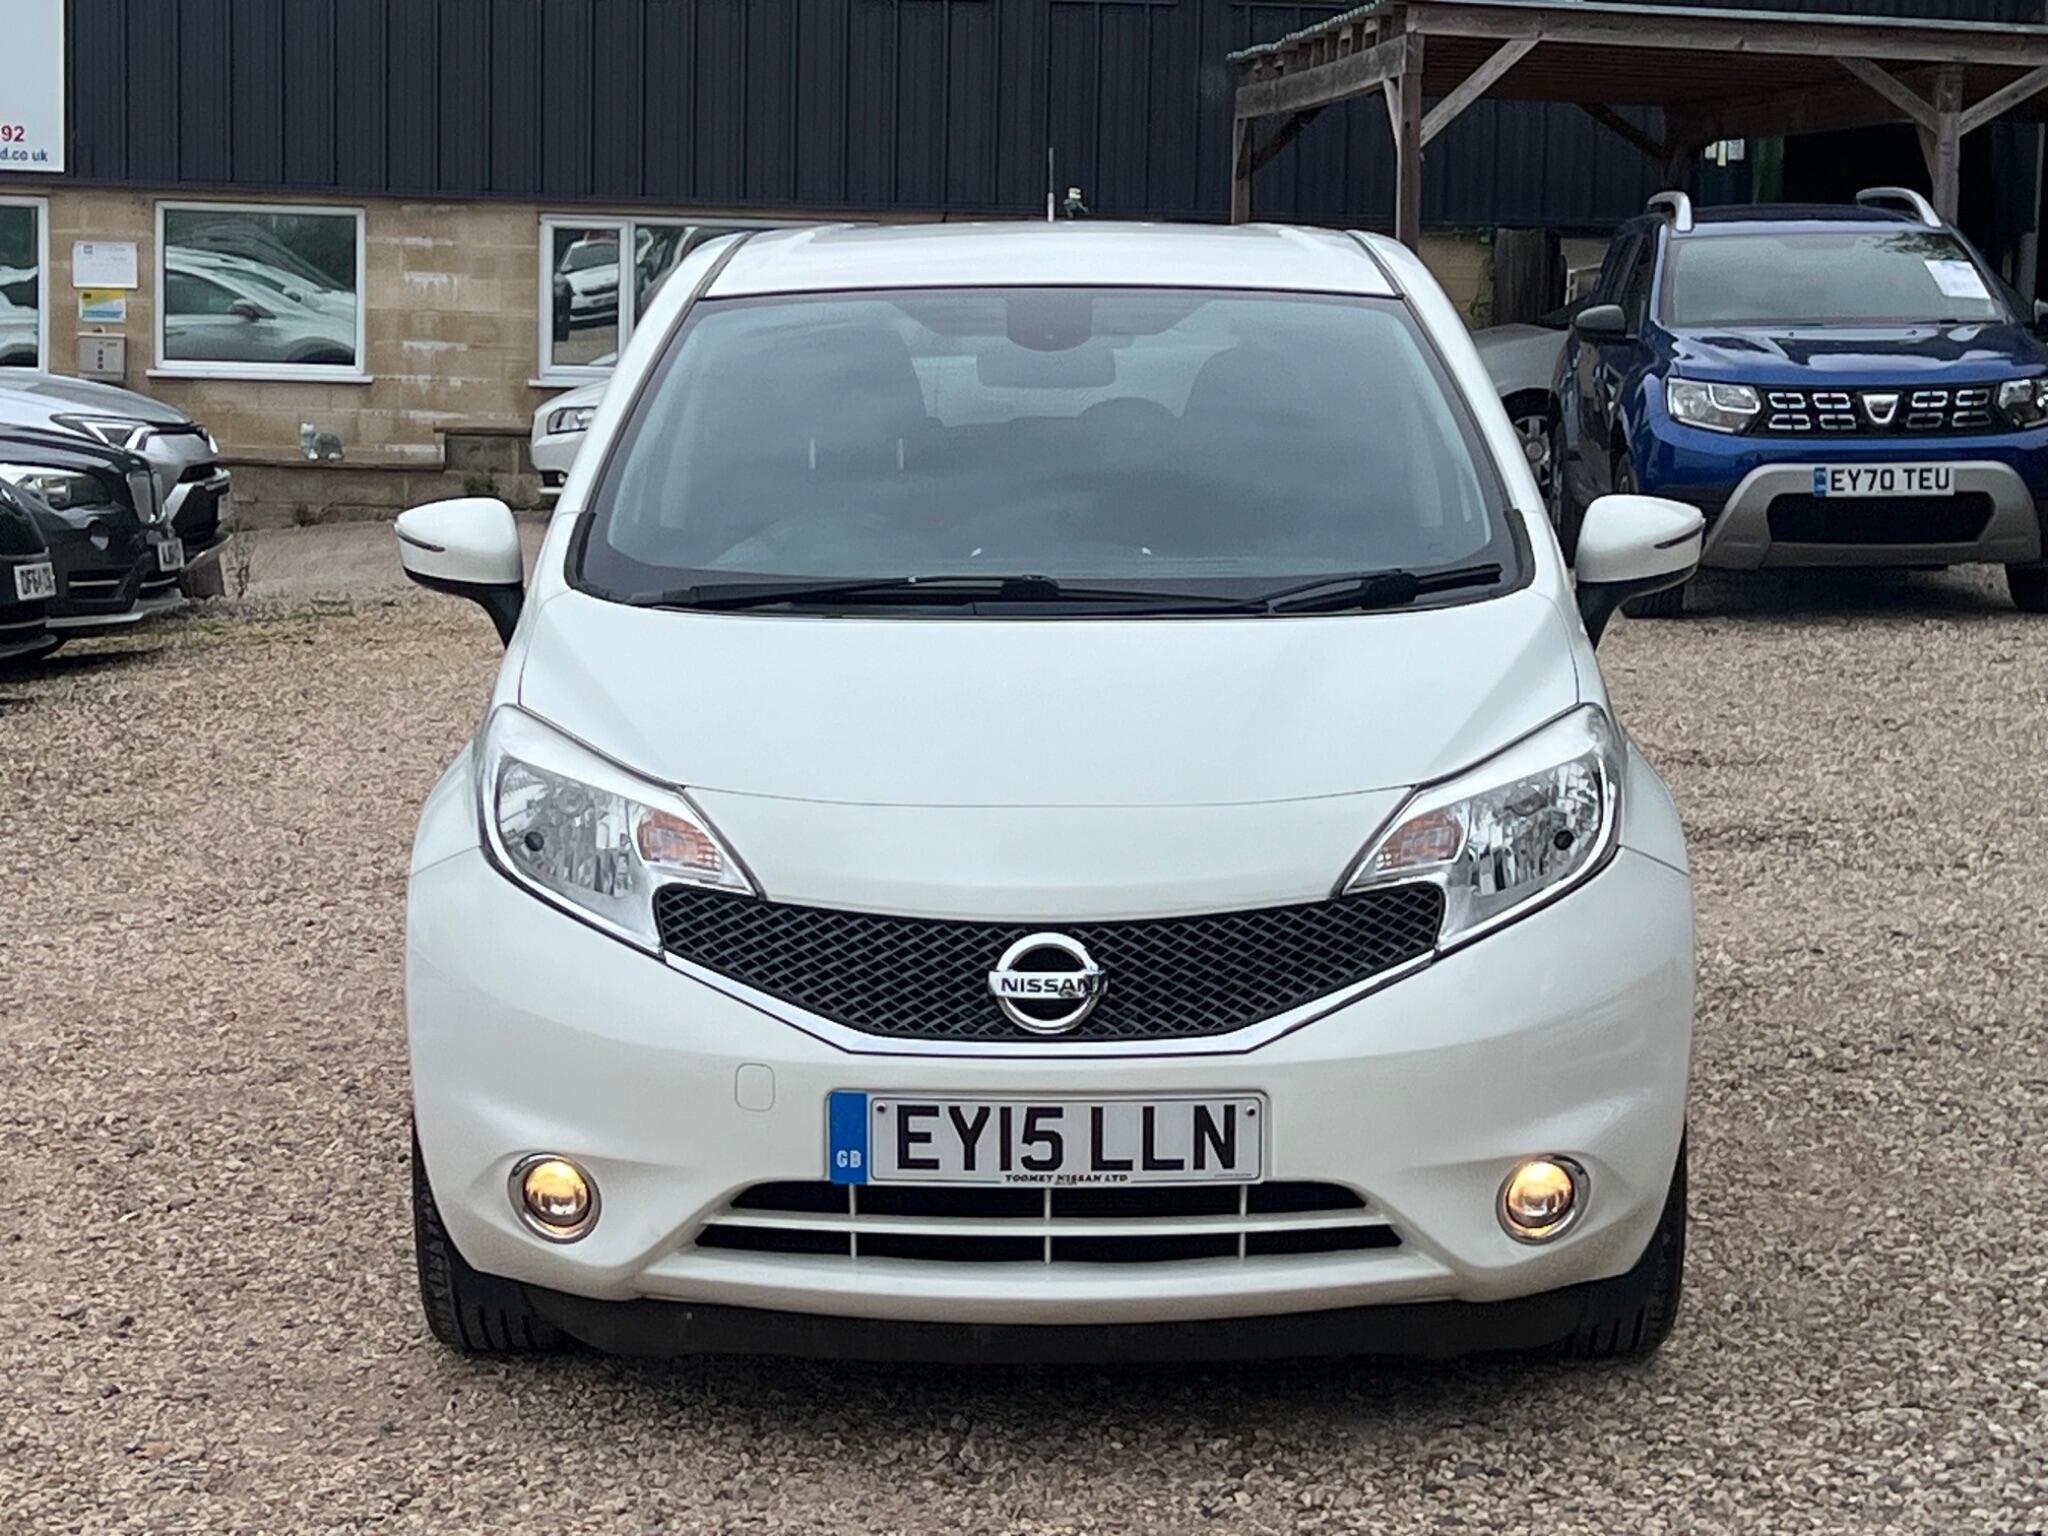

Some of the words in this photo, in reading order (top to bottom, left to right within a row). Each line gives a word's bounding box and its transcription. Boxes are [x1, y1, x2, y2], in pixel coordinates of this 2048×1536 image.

[1, 125, 25, 142] 92
[0, 147, 48, 162] d.couk
[1830, 468, 1895, 491] EY70
[1903, 467, 1950, 490] TEU
[1001, 977, 1093, 993] NISSAN
[897, 1104, 1064, 1172] EY15
[1090, 1104, 1236, 1172] LLN
[836, 1149, 862, 1168] GB
[1056, 1174, 1101, 1184] NISSAN
[1104, 1174, 1128, 1183] LTD
